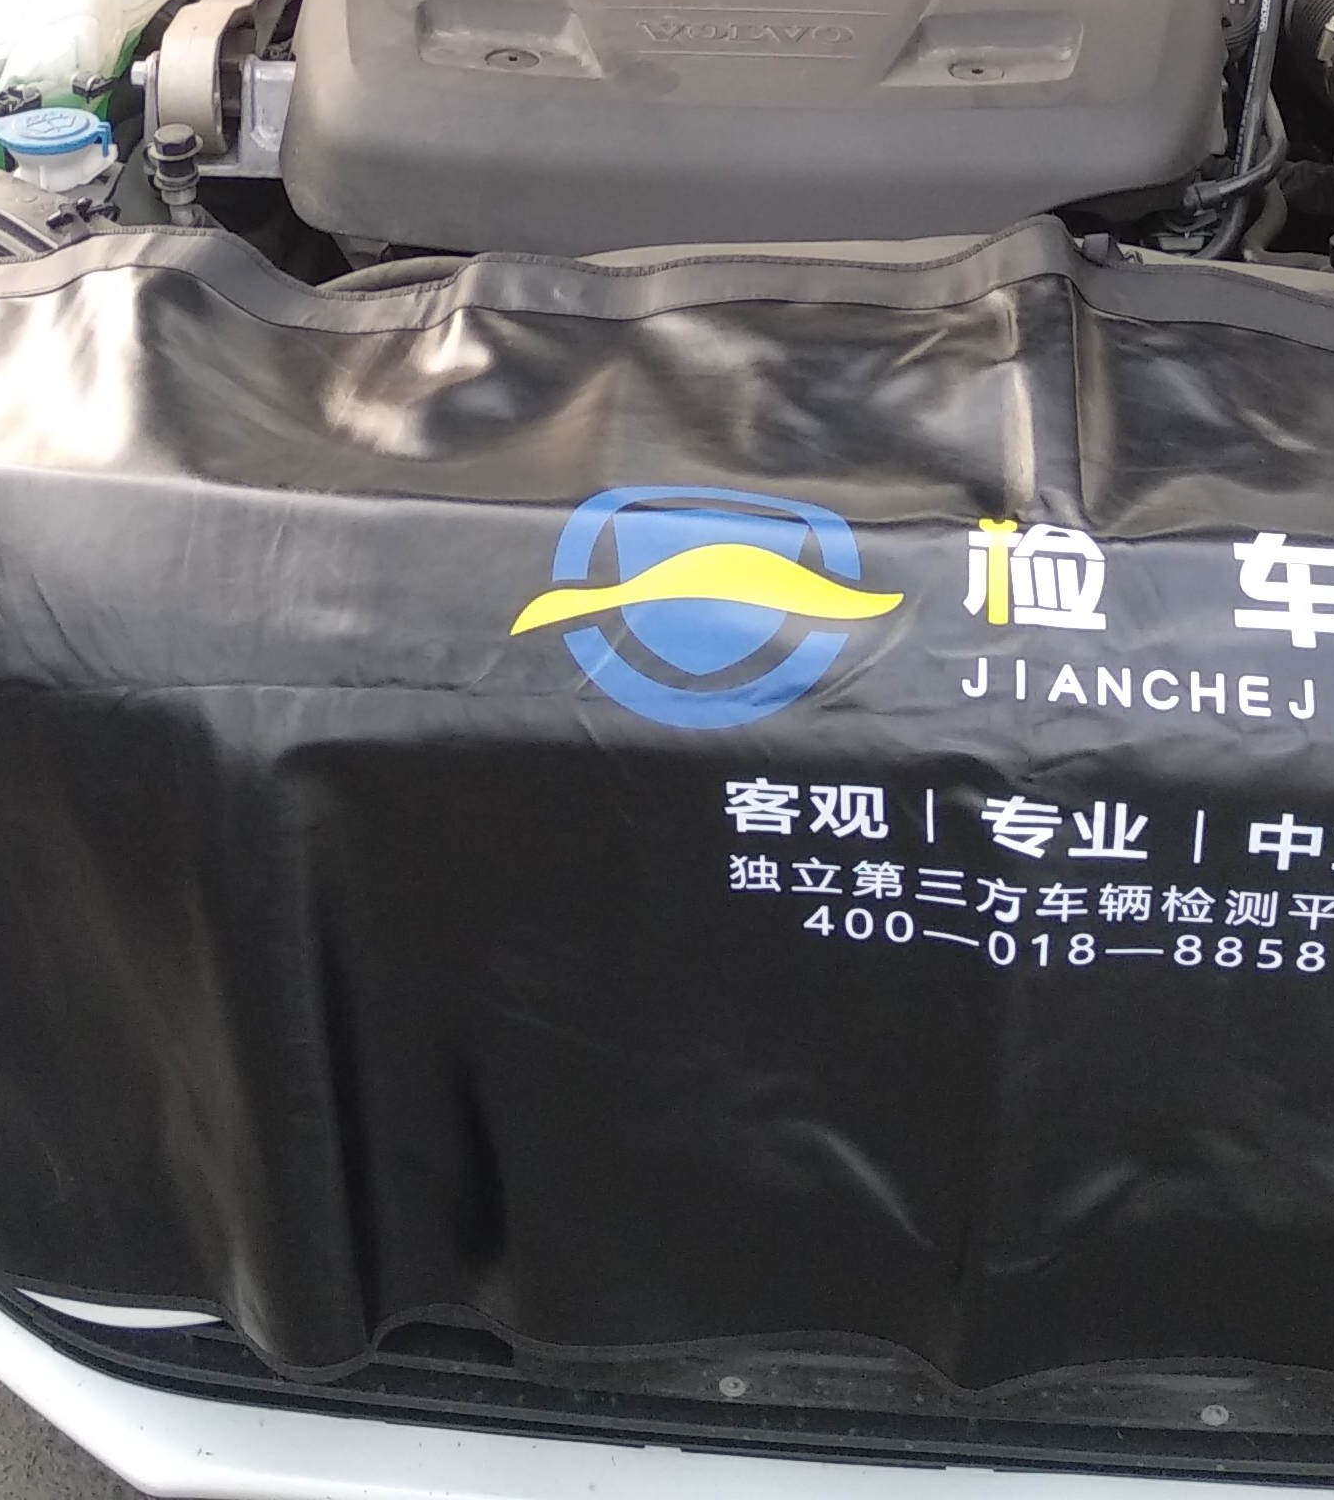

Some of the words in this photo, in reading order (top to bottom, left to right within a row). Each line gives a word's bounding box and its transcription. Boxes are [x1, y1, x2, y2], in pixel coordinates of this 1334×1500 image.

[635, 18, 856, 44] VOLVO
[724, 777, 889, 839] 客观
[980, 795, 1149, 860] 专业
